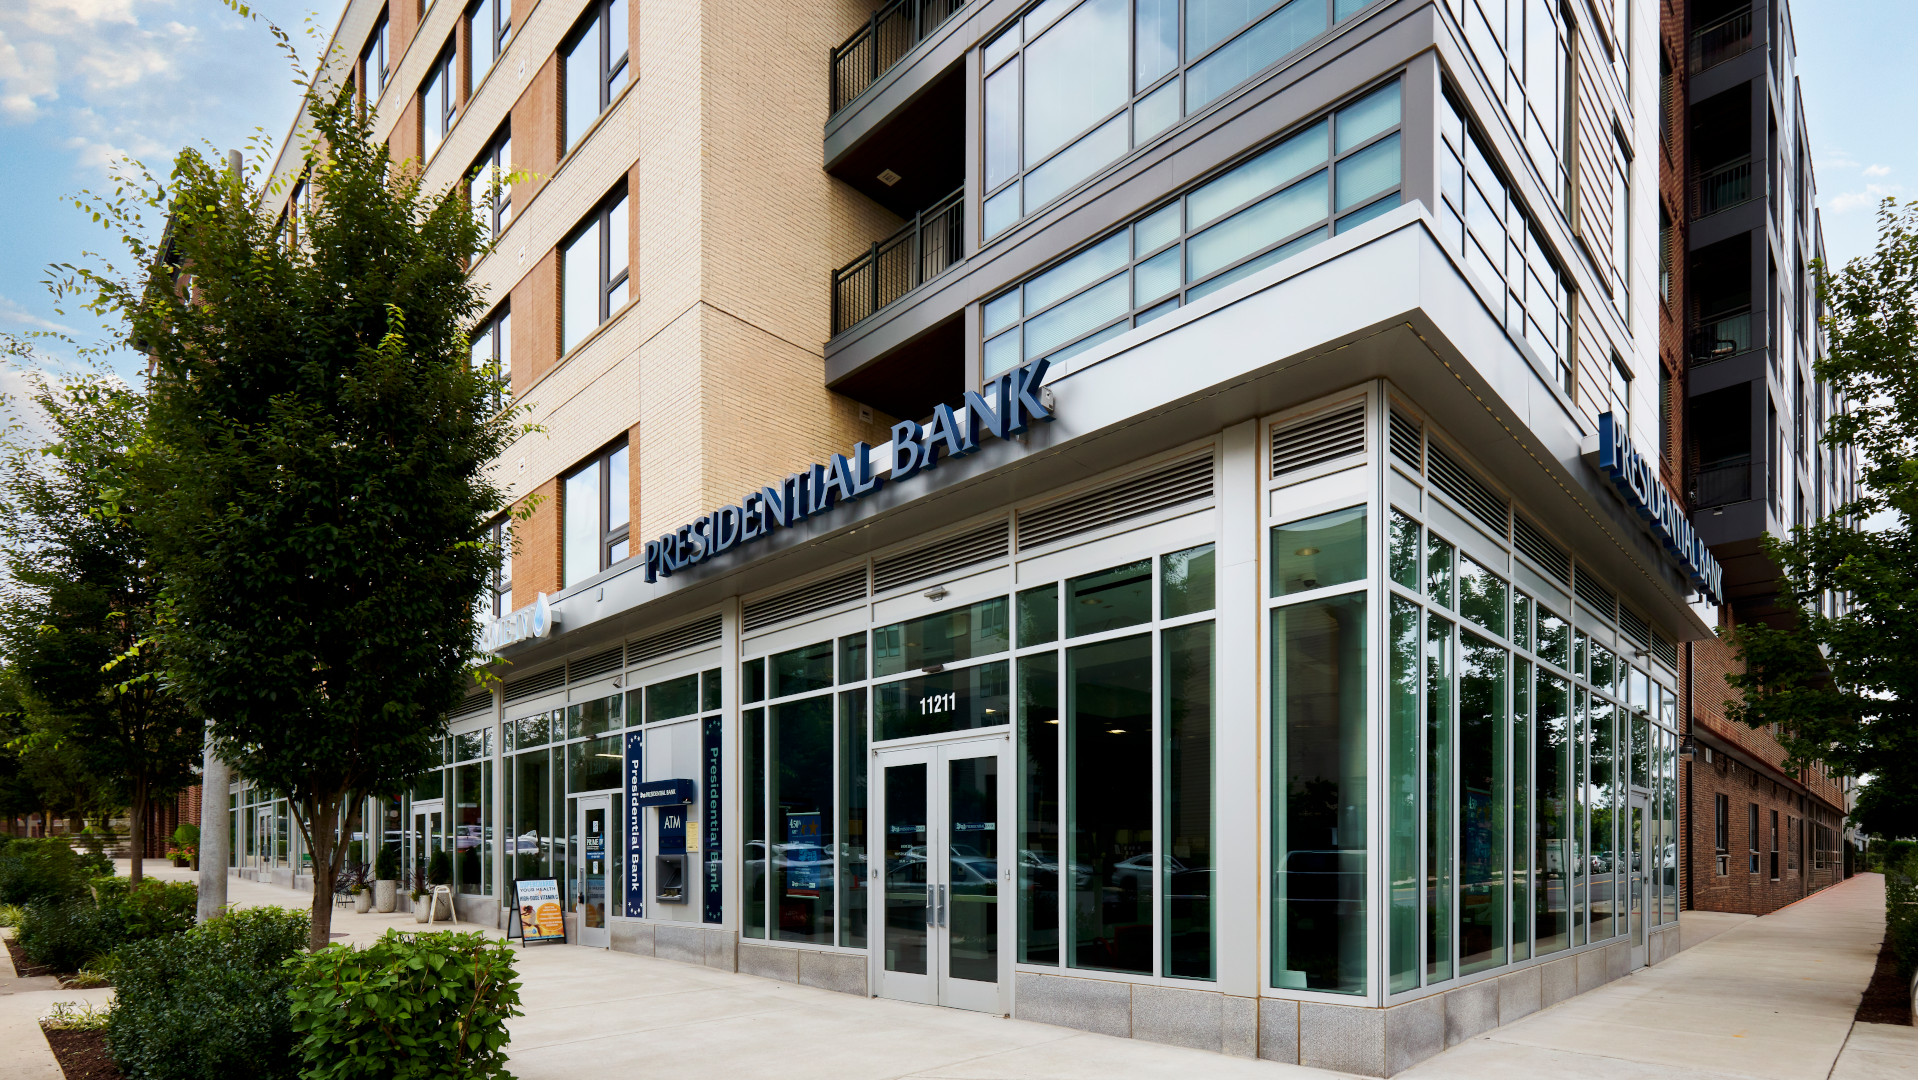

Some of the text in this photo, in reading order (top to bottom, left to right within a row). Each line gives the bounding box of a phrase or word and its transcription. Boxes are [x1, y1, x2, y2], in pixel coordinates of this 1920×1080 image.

[644, 358, 1056, 584] PRESIDENTIAL BANK
[1602, 412, 1724, 606] PRESIDENTIAL BANK
[919, 692, 956, 715] 11211
[631, 759, 640, 891] Presidential Bank
[664, 815, 681, 829] ATM
[666, 788, 677, 796] BANK
[710, 747, 719, 892] Presidential Bank
